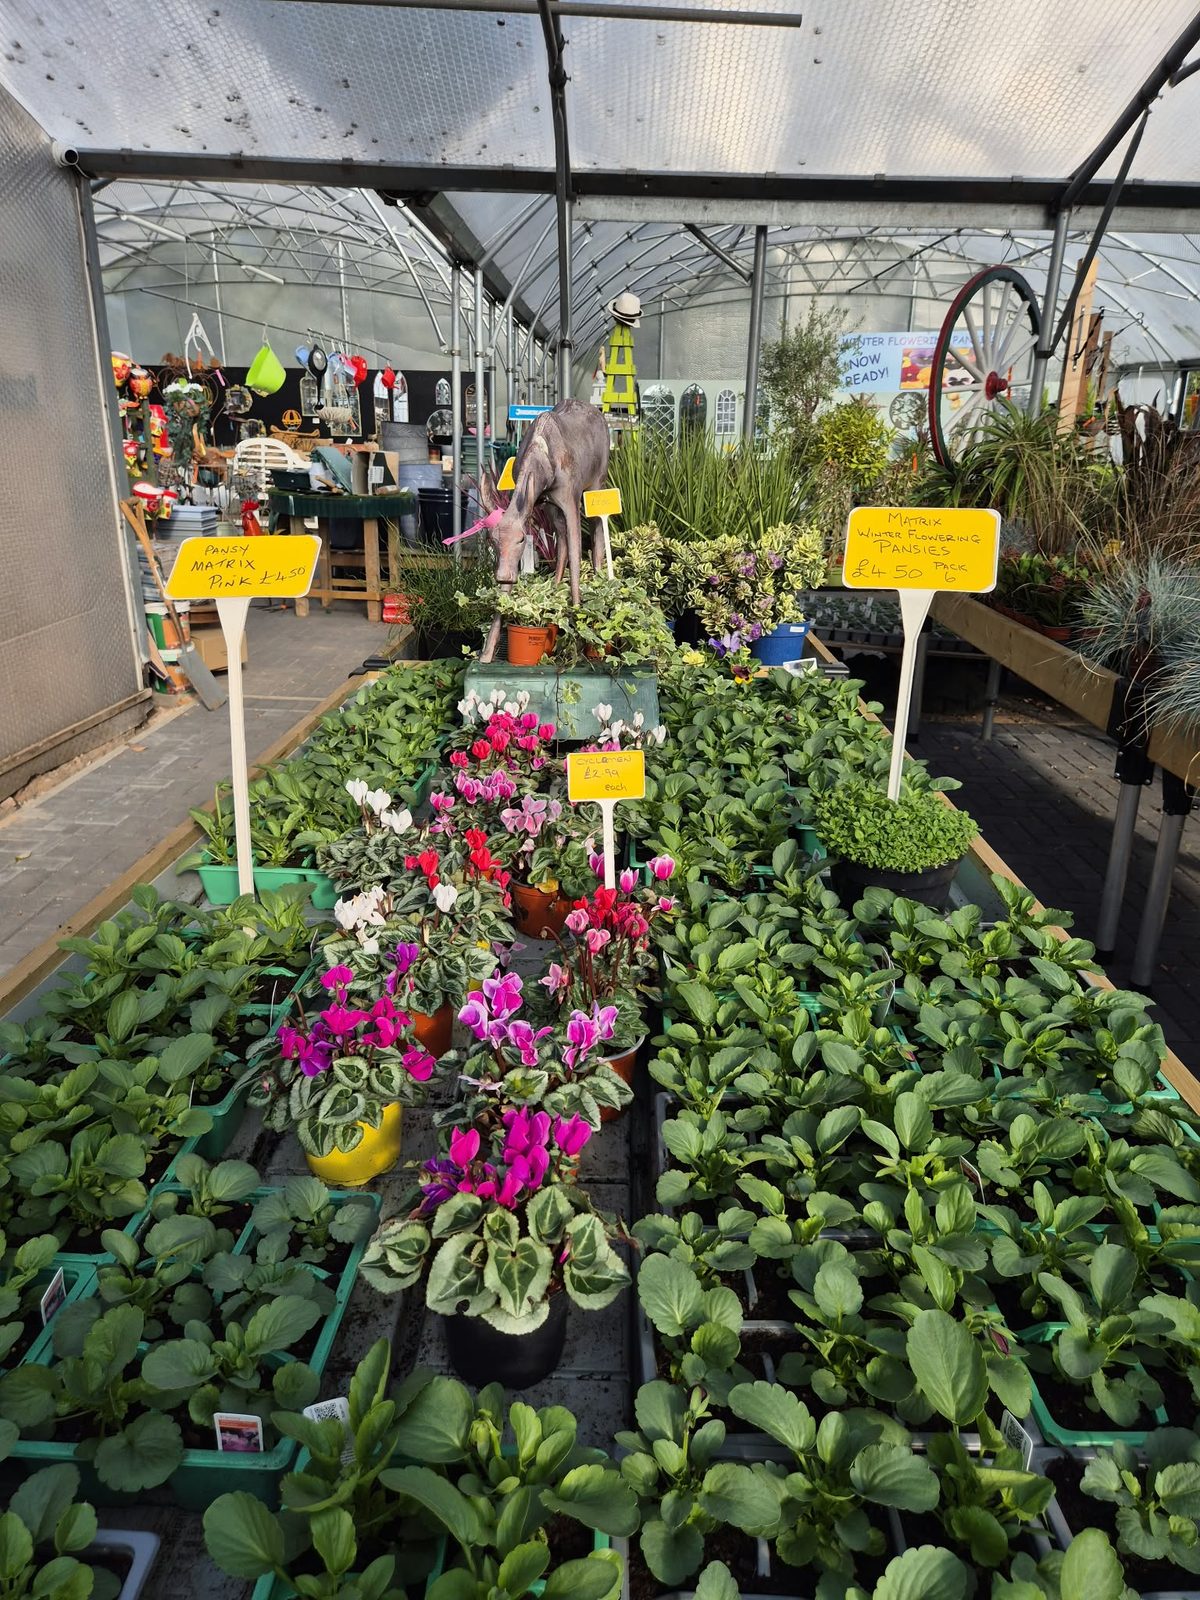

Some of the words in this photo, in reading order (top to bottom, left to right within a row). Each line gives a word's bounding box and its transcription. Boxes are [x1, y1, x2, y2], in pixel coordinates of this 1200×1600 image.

[850, 353, 881, 369] NOW
[845, 367, 889, 387] READY!
[888, 512, 942, 527] MATRIX
[857, 528, 902, 539] WINTER
[908, 529, 982, 544] FLOWERING
[204, 544, 250, 556] PANSY
[873, 539, 951, 556] PANSIES
[190, 559, 256, 572] MATRIX
[933, 561, 968, 572] PACK
[944, 571, 956, 583] 6
[604, 783, 628, 792] each
